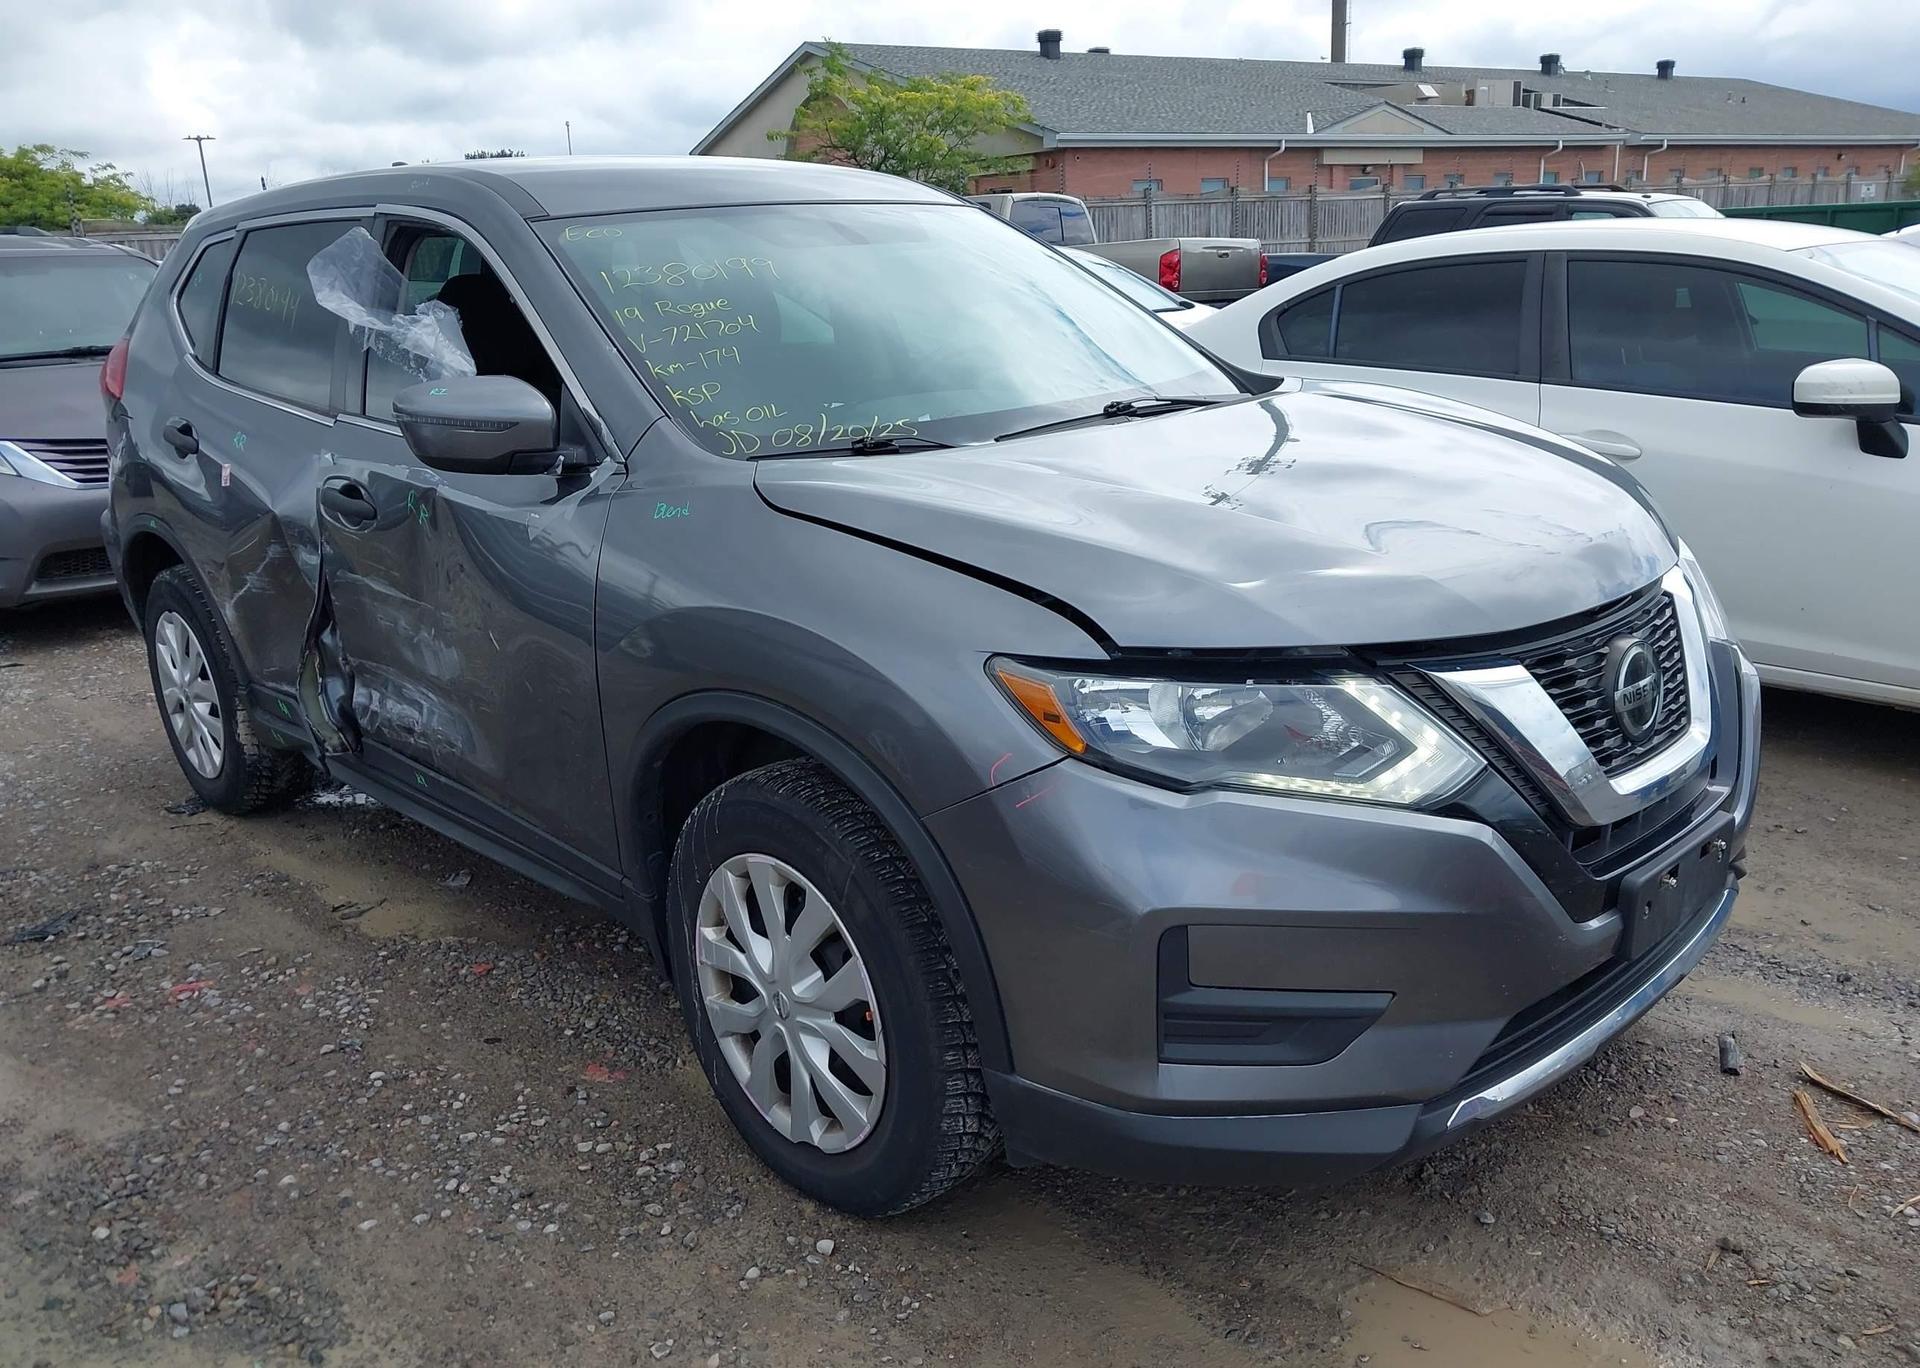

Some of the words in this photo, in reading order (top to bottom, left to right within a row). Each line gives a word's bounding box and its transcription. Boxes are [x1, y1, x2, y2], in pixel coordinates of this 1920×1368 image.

[600, 257, 780, 295] 12380199
[614, 306, 646, 327] 19
[655, 298, 733, 319] Rogue
[689, 410, 740, 429] has
[714, 429, 762, 455] JD
[771, 413, 918, 448] 08/20/25
